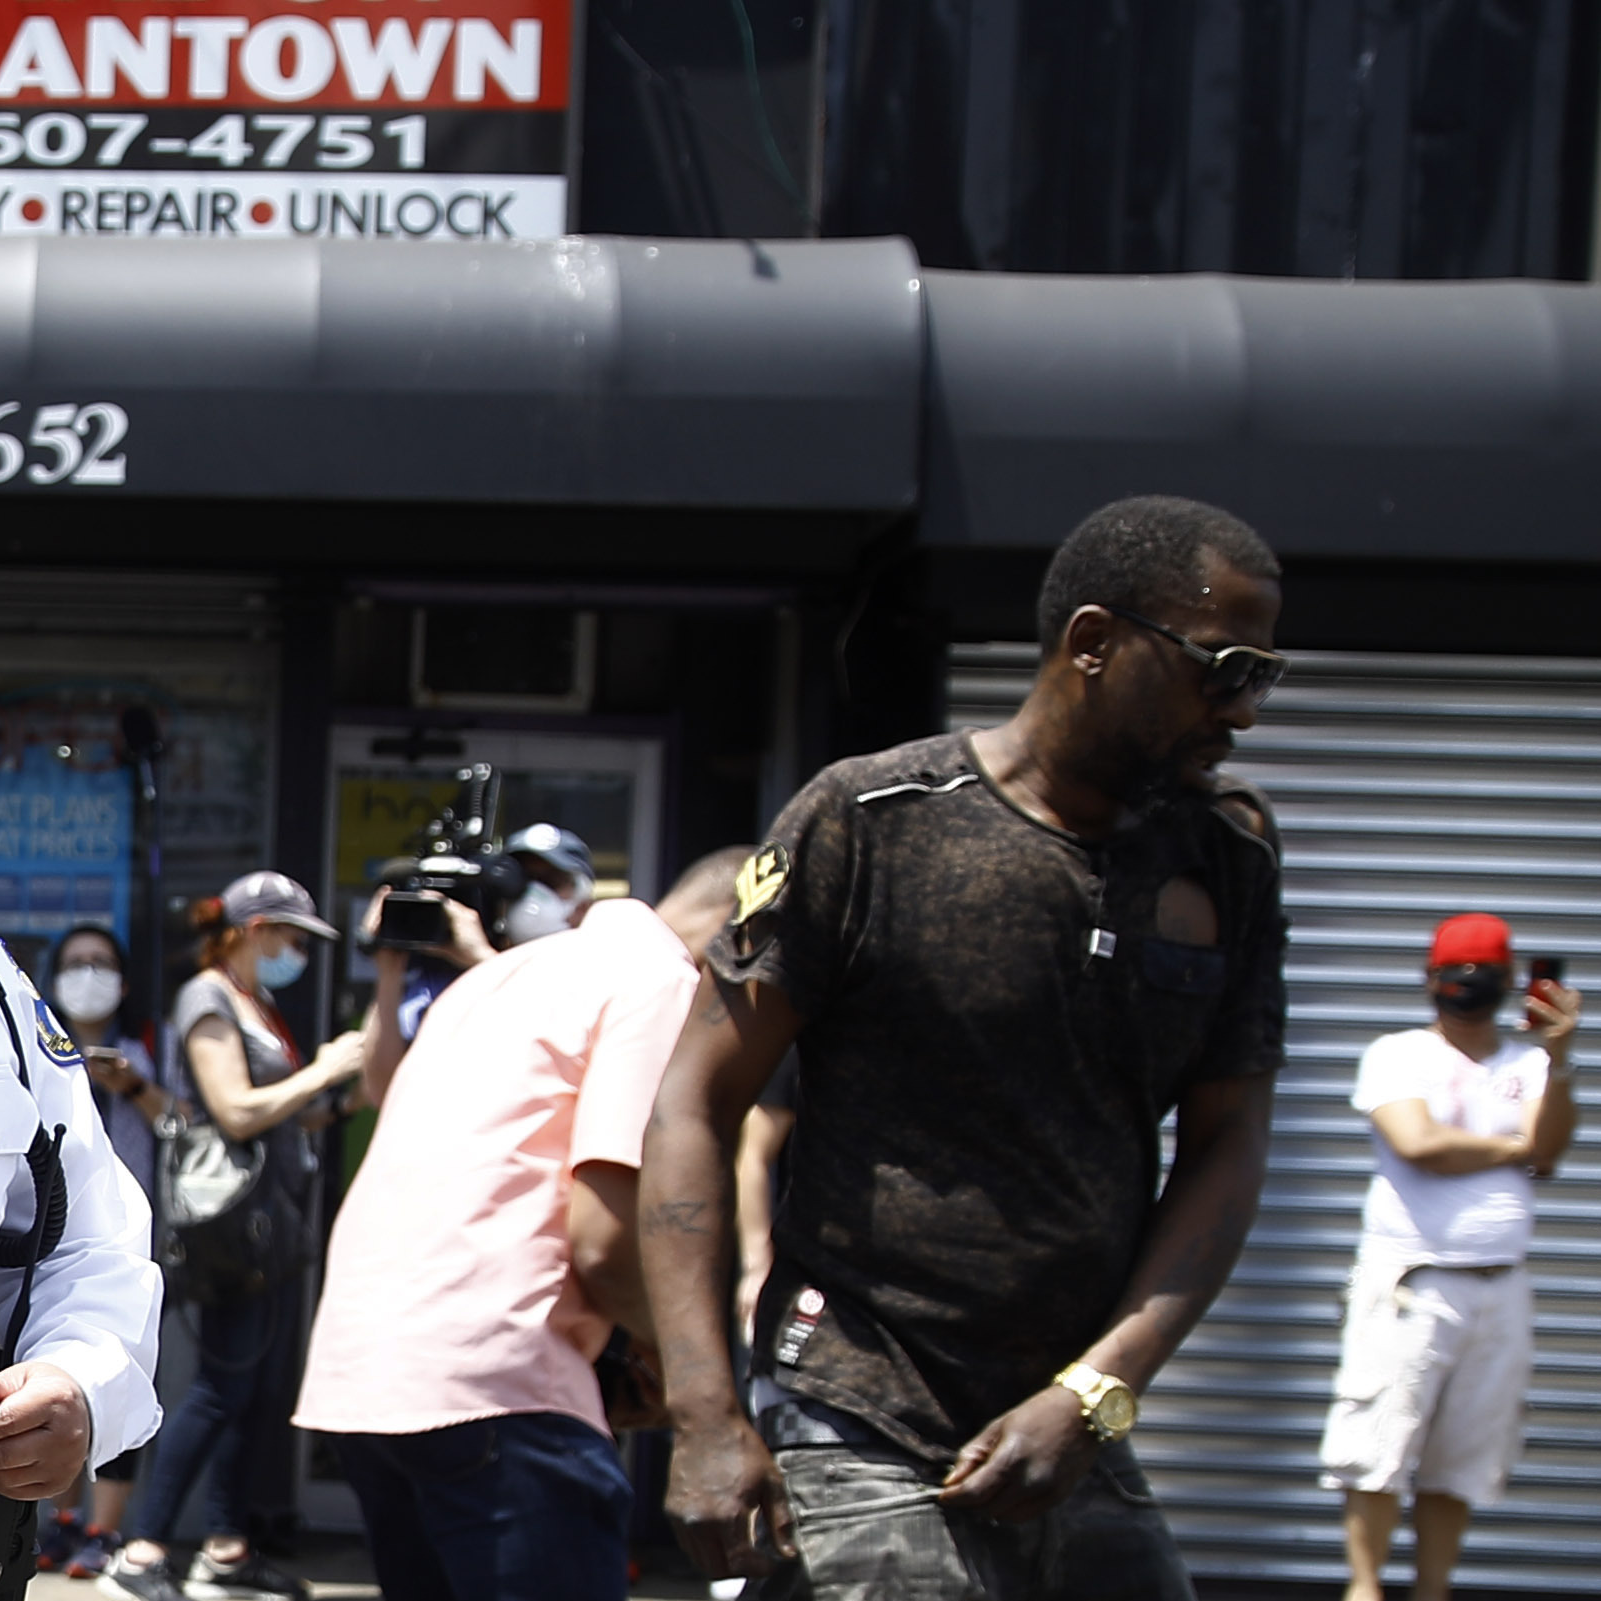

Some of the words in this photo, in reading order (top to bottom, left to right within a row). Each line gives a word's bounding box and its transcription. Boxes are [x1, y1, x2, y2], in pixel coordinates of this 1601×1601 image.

[62, 190, 239, 234] REPAIR
[290, 188, 516, 237] UNLOCK
[30, 794, 118, 827] PLANS
